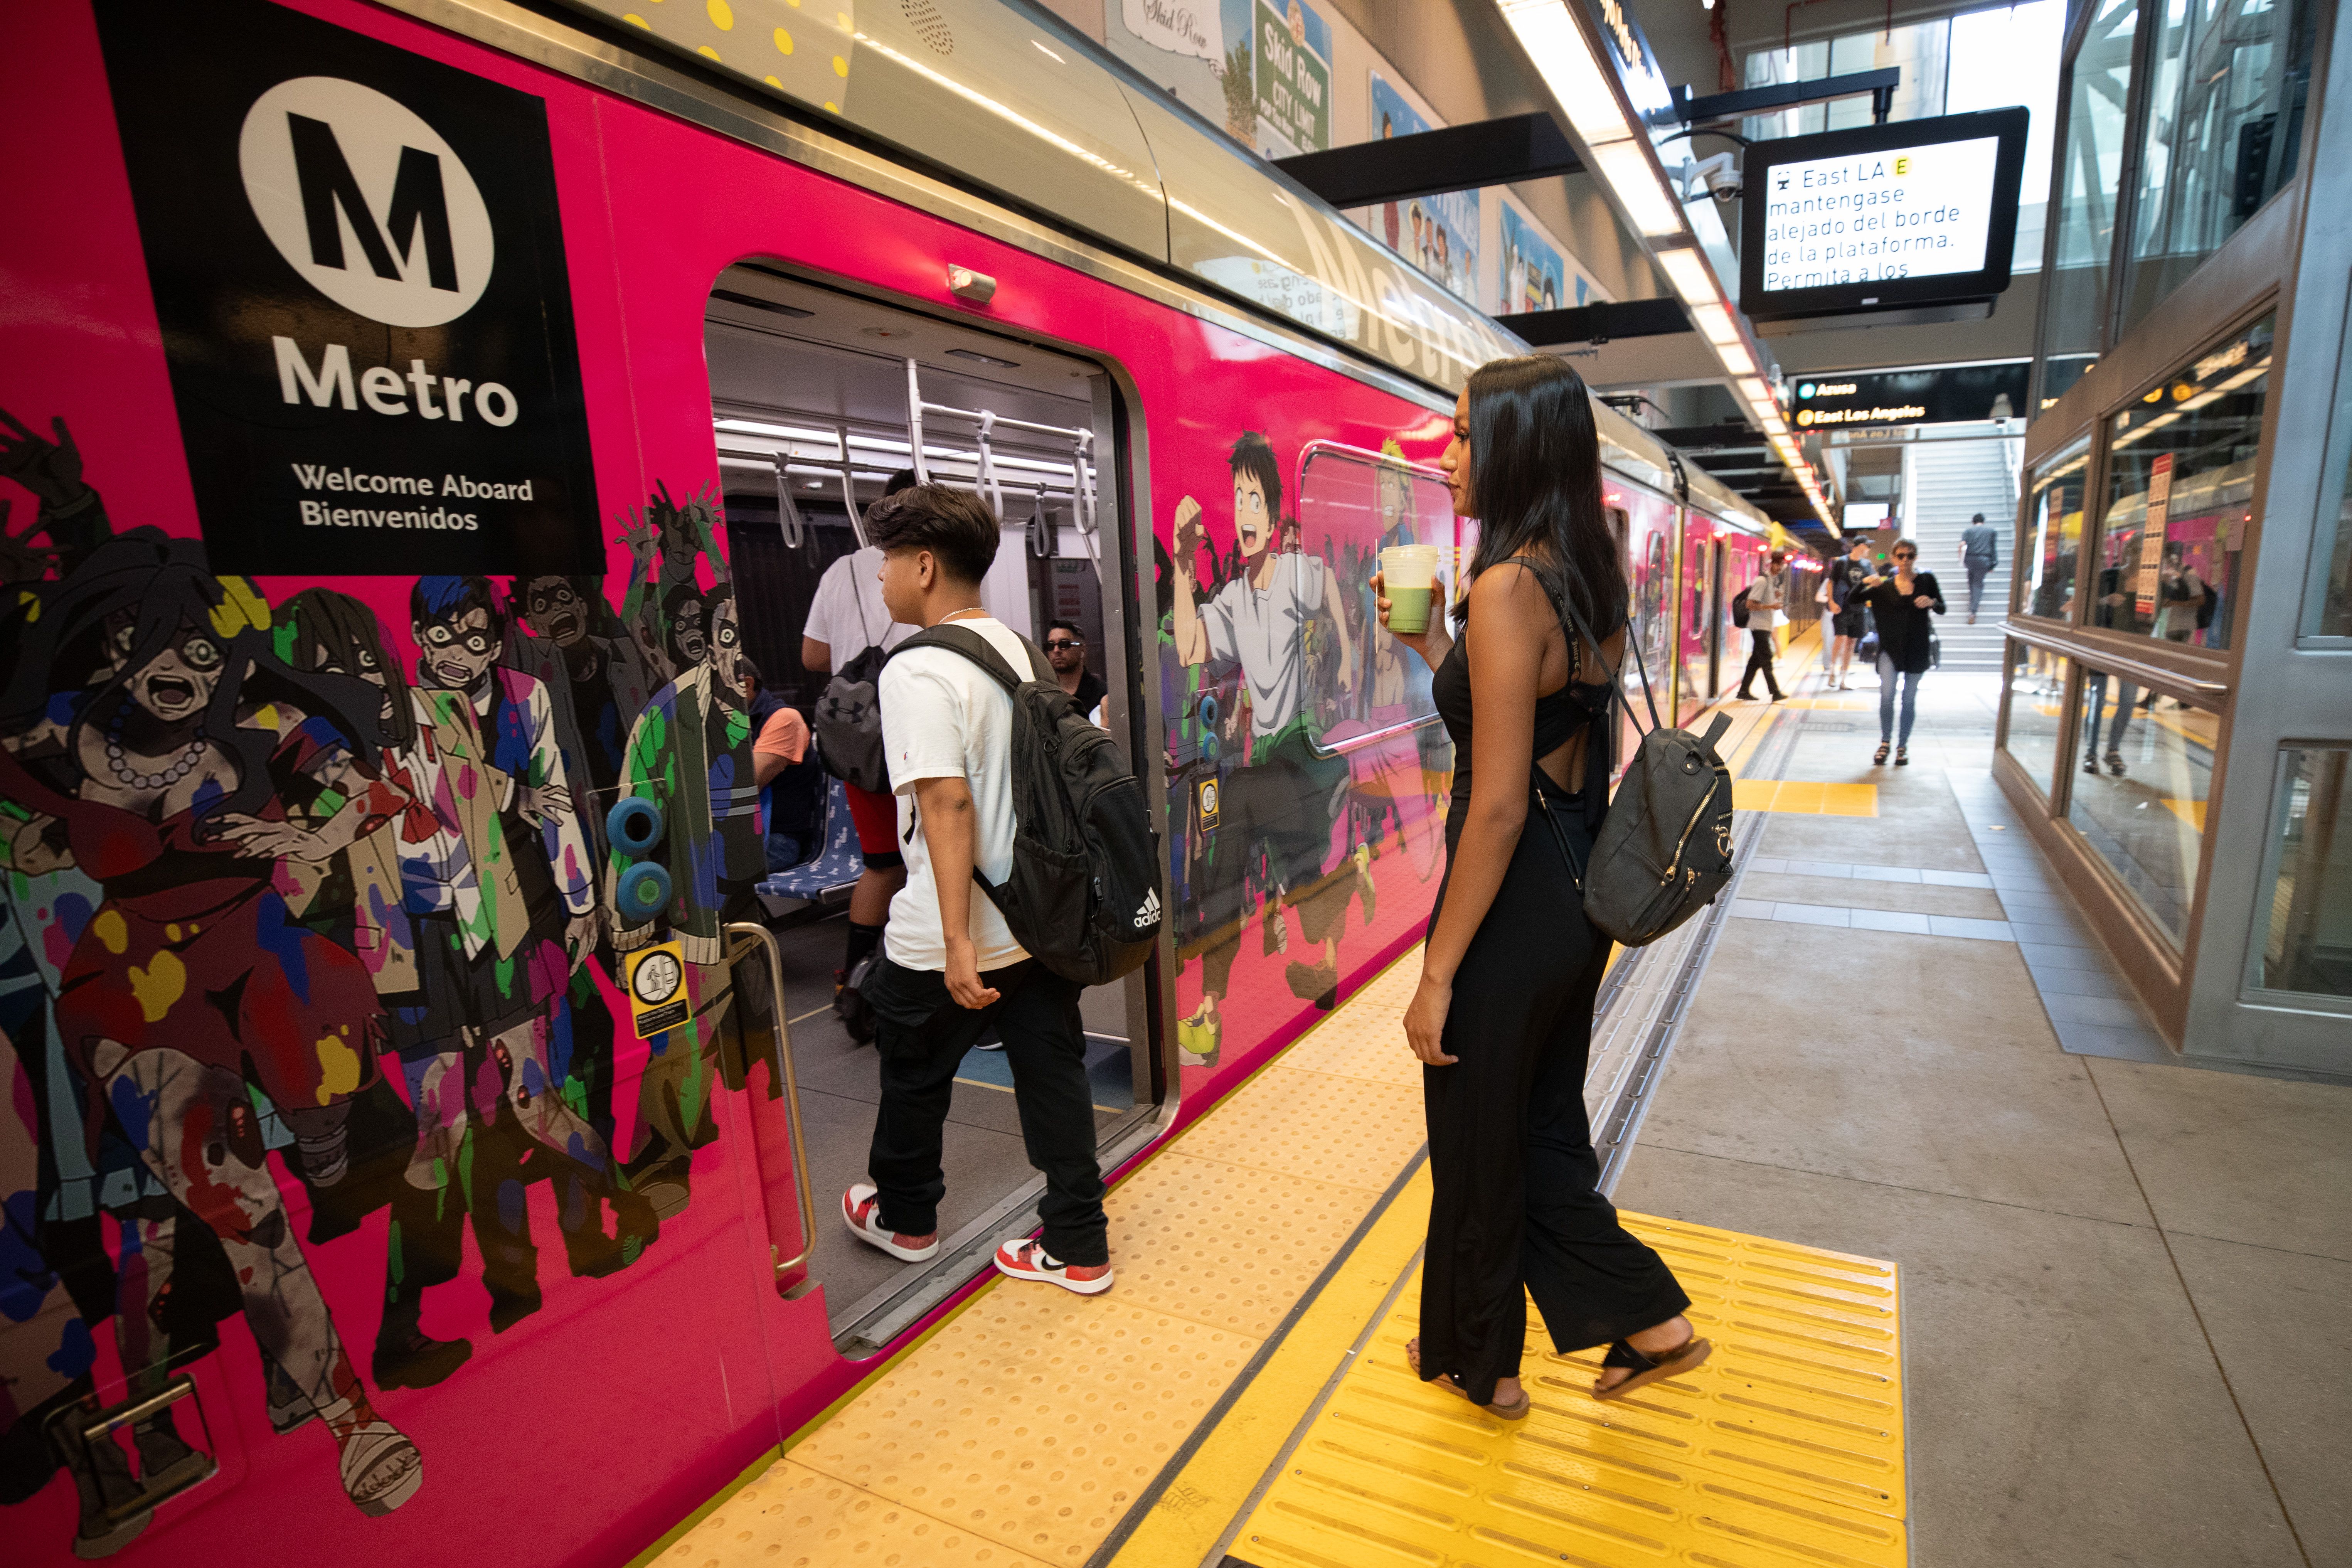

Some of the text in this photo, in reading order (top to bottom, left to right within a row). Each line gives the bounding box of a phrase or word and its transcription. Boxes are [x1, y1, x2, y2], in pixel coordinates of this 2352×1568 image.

[1264, 22, 1293, 81] Skid
[1273, 80, 1315, 139] CITY LIMIT
[1803, 158, 1907, 188] East LA E
[286, 111, 460, 294] M
[1770, 189, 1904, 217] mantengase
[1768, 205, 1960, 243] alejado del borde
[1768, 234, 1955, 265] de la plataforma.
[1767, 262, 1908, 291] Permita a los
[271, 335, 519, 427] Metro
[1815, 383, 1857, 397] Azusa
[1813, 410, 1844, 424] East
[1844, 408, 1870, 422] Los
[1870, 405, 1926, 422] Angeles
[291, 463, 534, 502] Welcome Aboard
[299, 500, 479, 531] Bienvenidos
